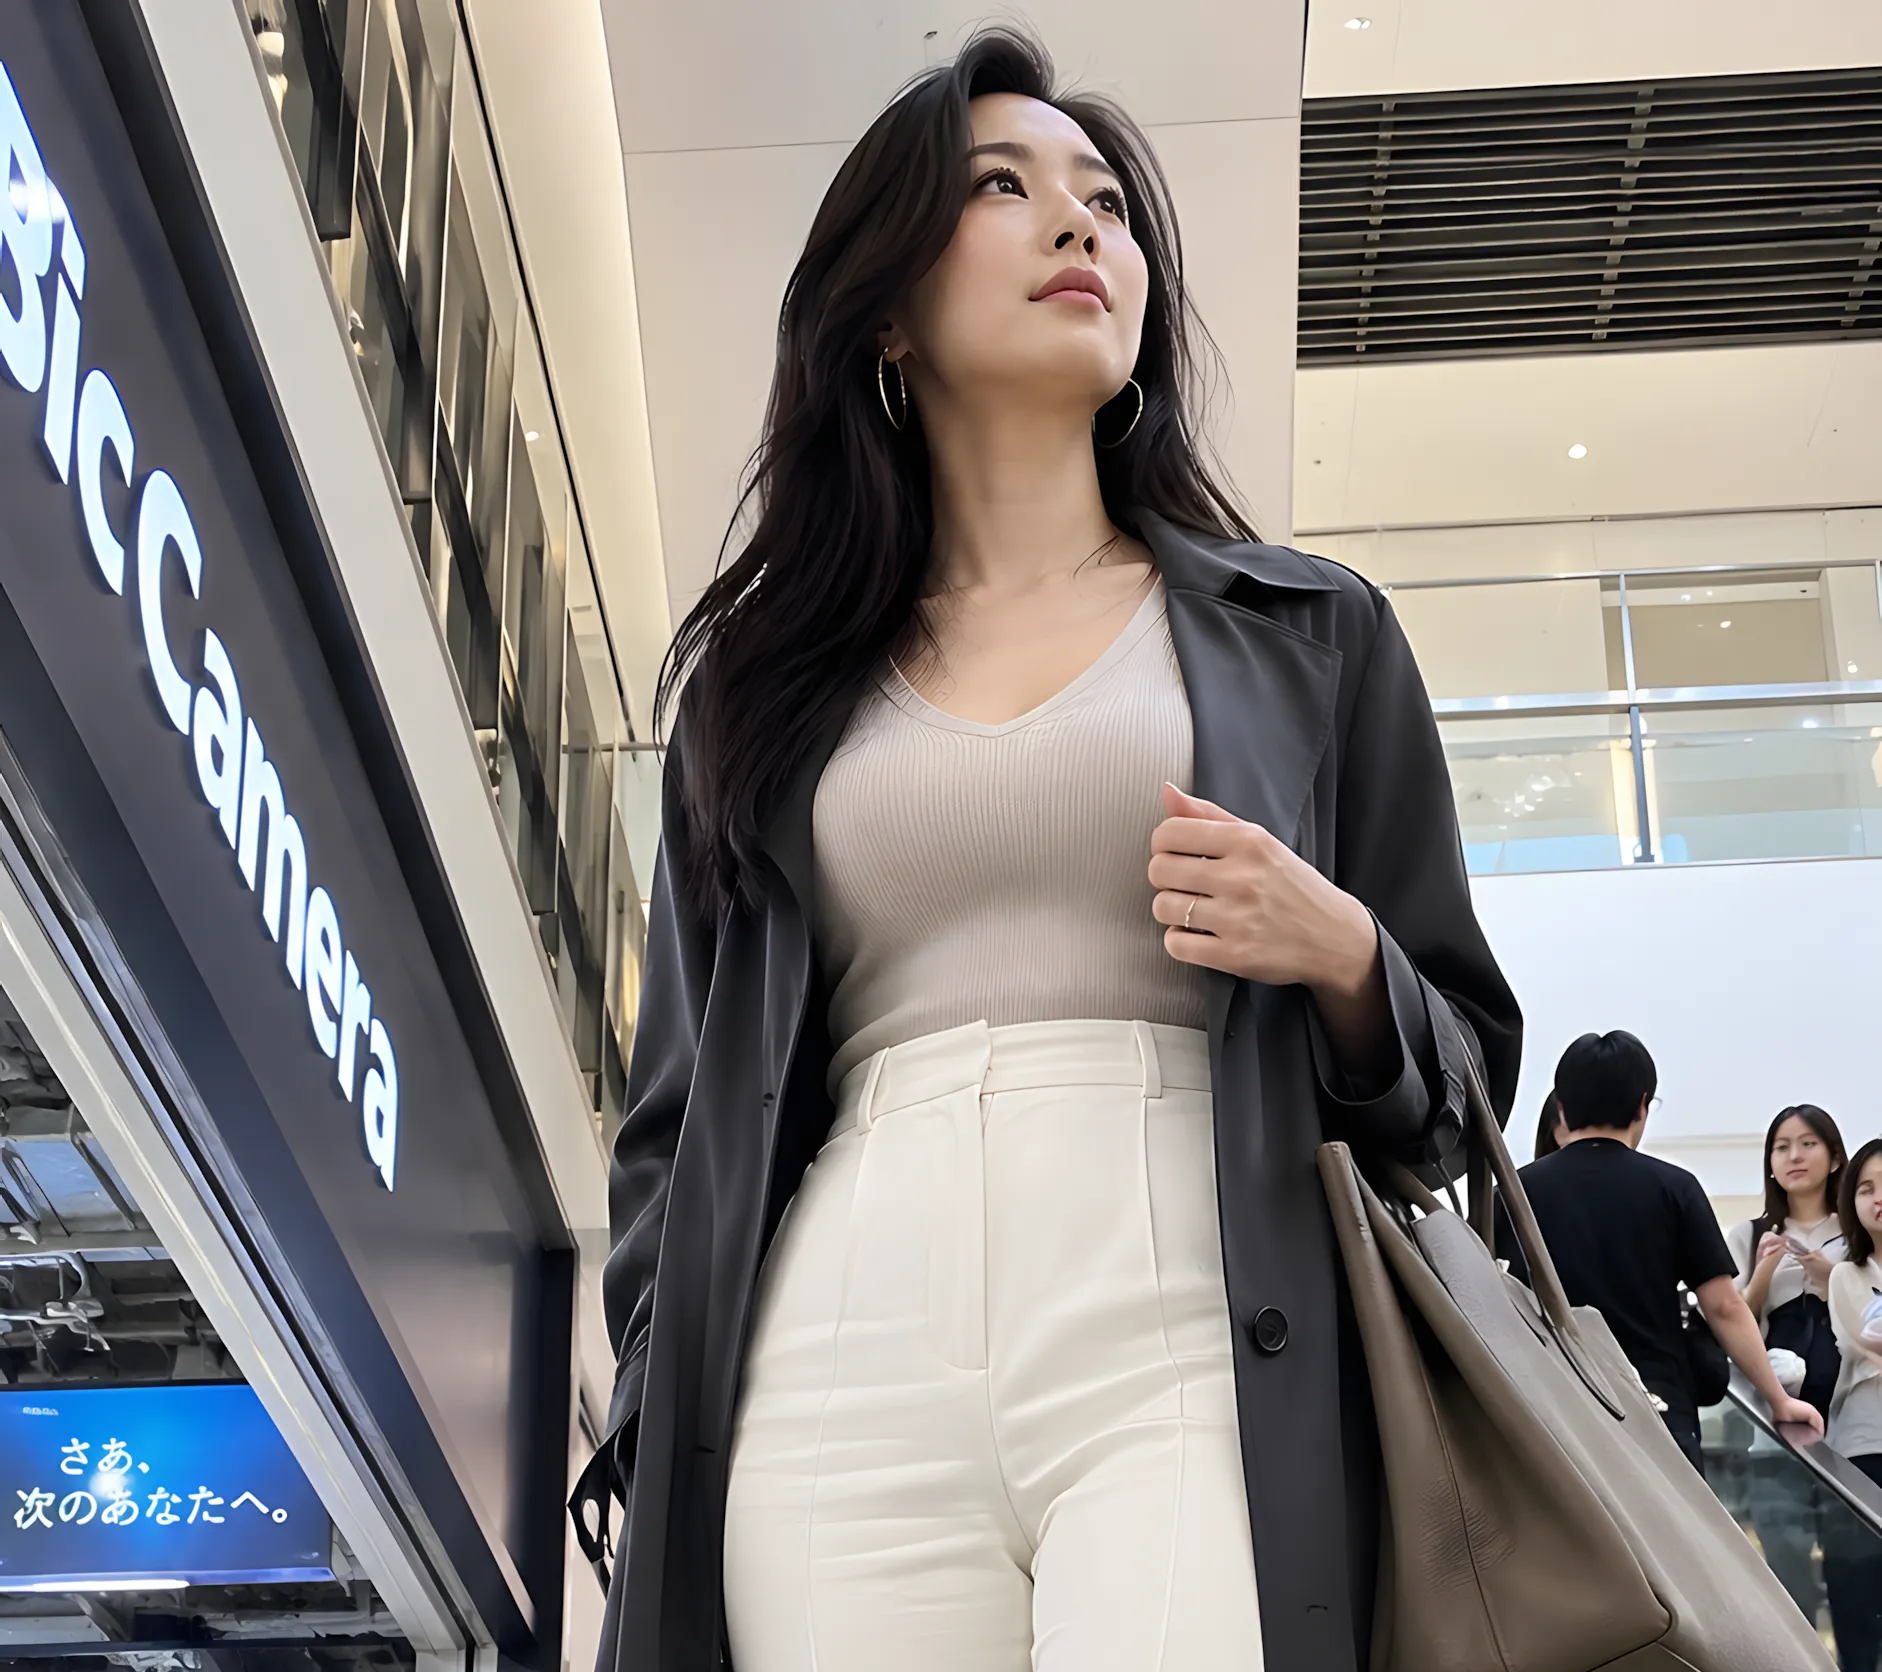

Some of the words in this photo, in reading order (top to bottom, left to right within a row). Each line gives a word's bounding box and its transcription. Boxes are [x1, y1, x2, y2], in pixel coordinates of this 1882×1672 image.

[60, 1438, 150, 1475] さあ、
[13, 1486, 288, 1529] 次のあなたへ。
